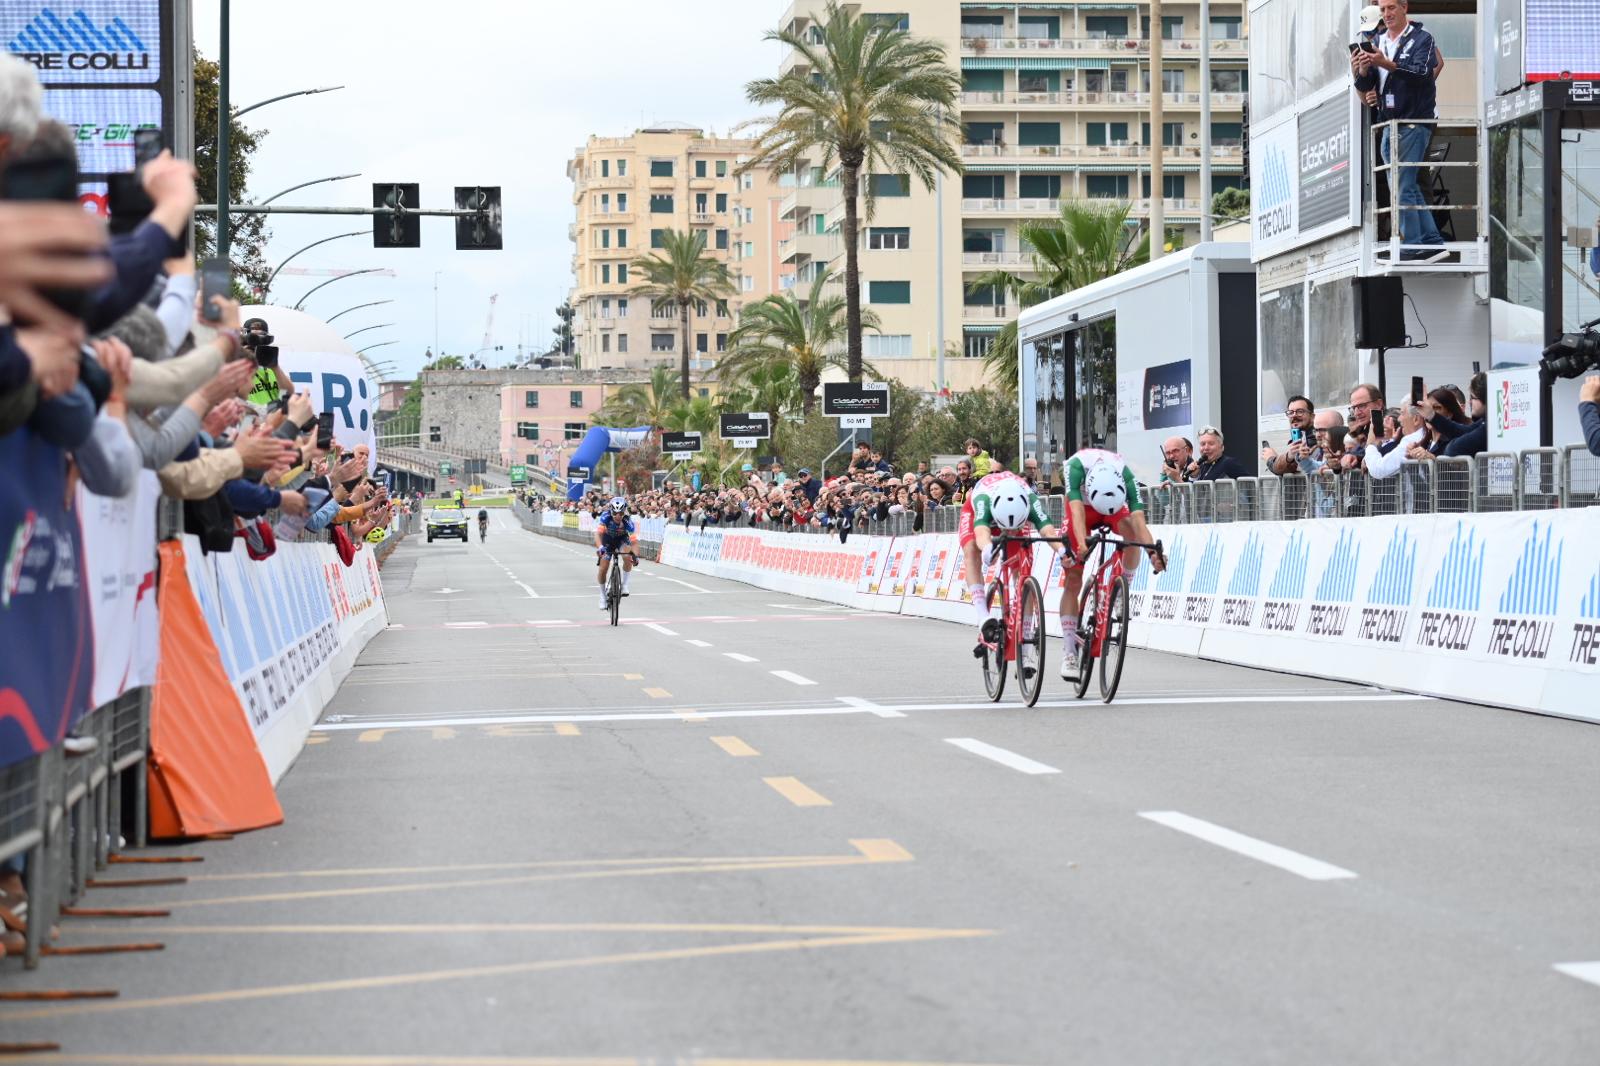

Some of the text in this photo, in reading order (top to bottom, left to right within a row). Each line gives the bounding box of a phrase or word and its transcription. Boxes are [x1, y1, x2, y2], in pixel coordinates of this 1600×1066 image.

[68, 52, 149, 70] COLLI
[1258, 203, 1291, 240] TRE COLLI
[1260, 602, 1301, 631] TRE COLLI
[1306, 604, 1350, 636] TRE COLLI
[1358, 608, 1408, 642] TRE COLLI
[1417, 611, 1476, 651] TRE COLLI
[1487, 618, 1554, 659] TRE COLLI
[1569, 623, 1600, 665] TRE
